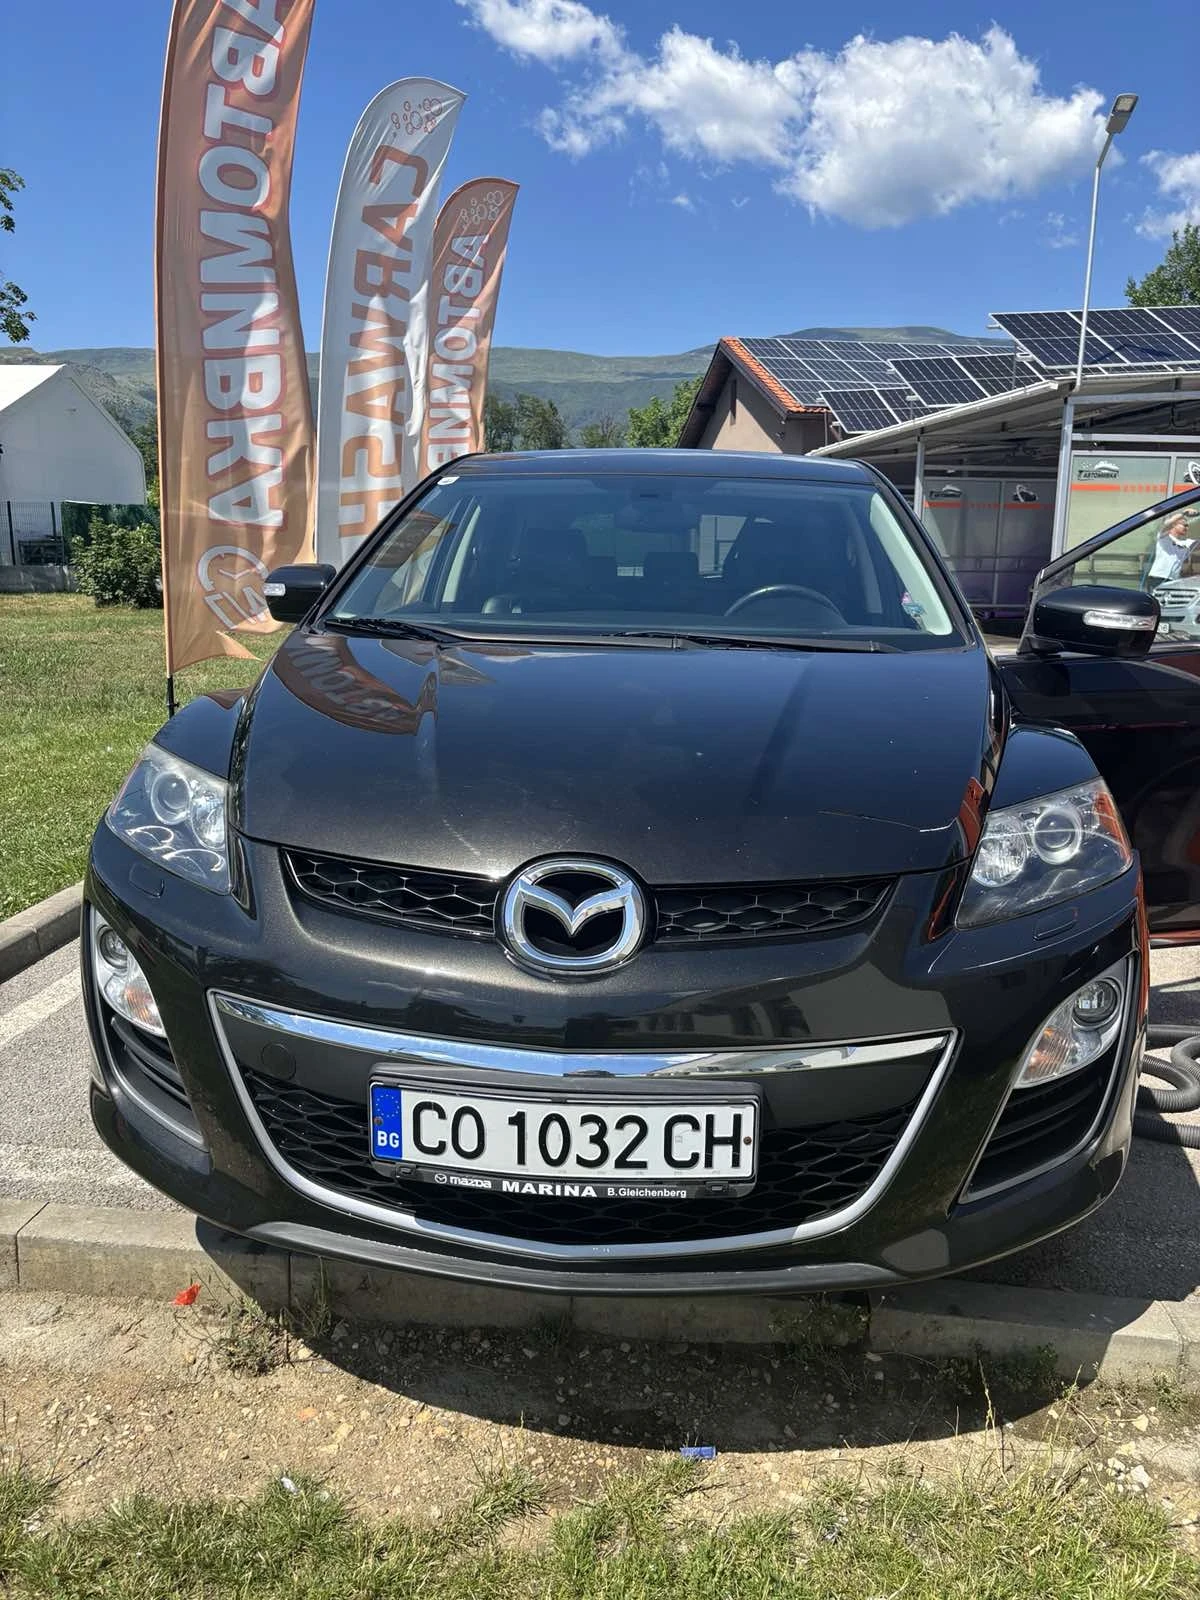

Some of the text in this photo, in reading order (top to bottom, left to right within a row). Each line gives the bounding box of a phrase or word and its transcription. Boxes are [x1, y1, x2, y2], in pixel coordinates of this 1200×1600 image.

[377, 1130, 400, 1148] BG
[412, 1101, 742, 1169] CO 1032 CH
[450, 1176, 492, 1188] mazda
[502, 1180, 597, 1197] MARINA
